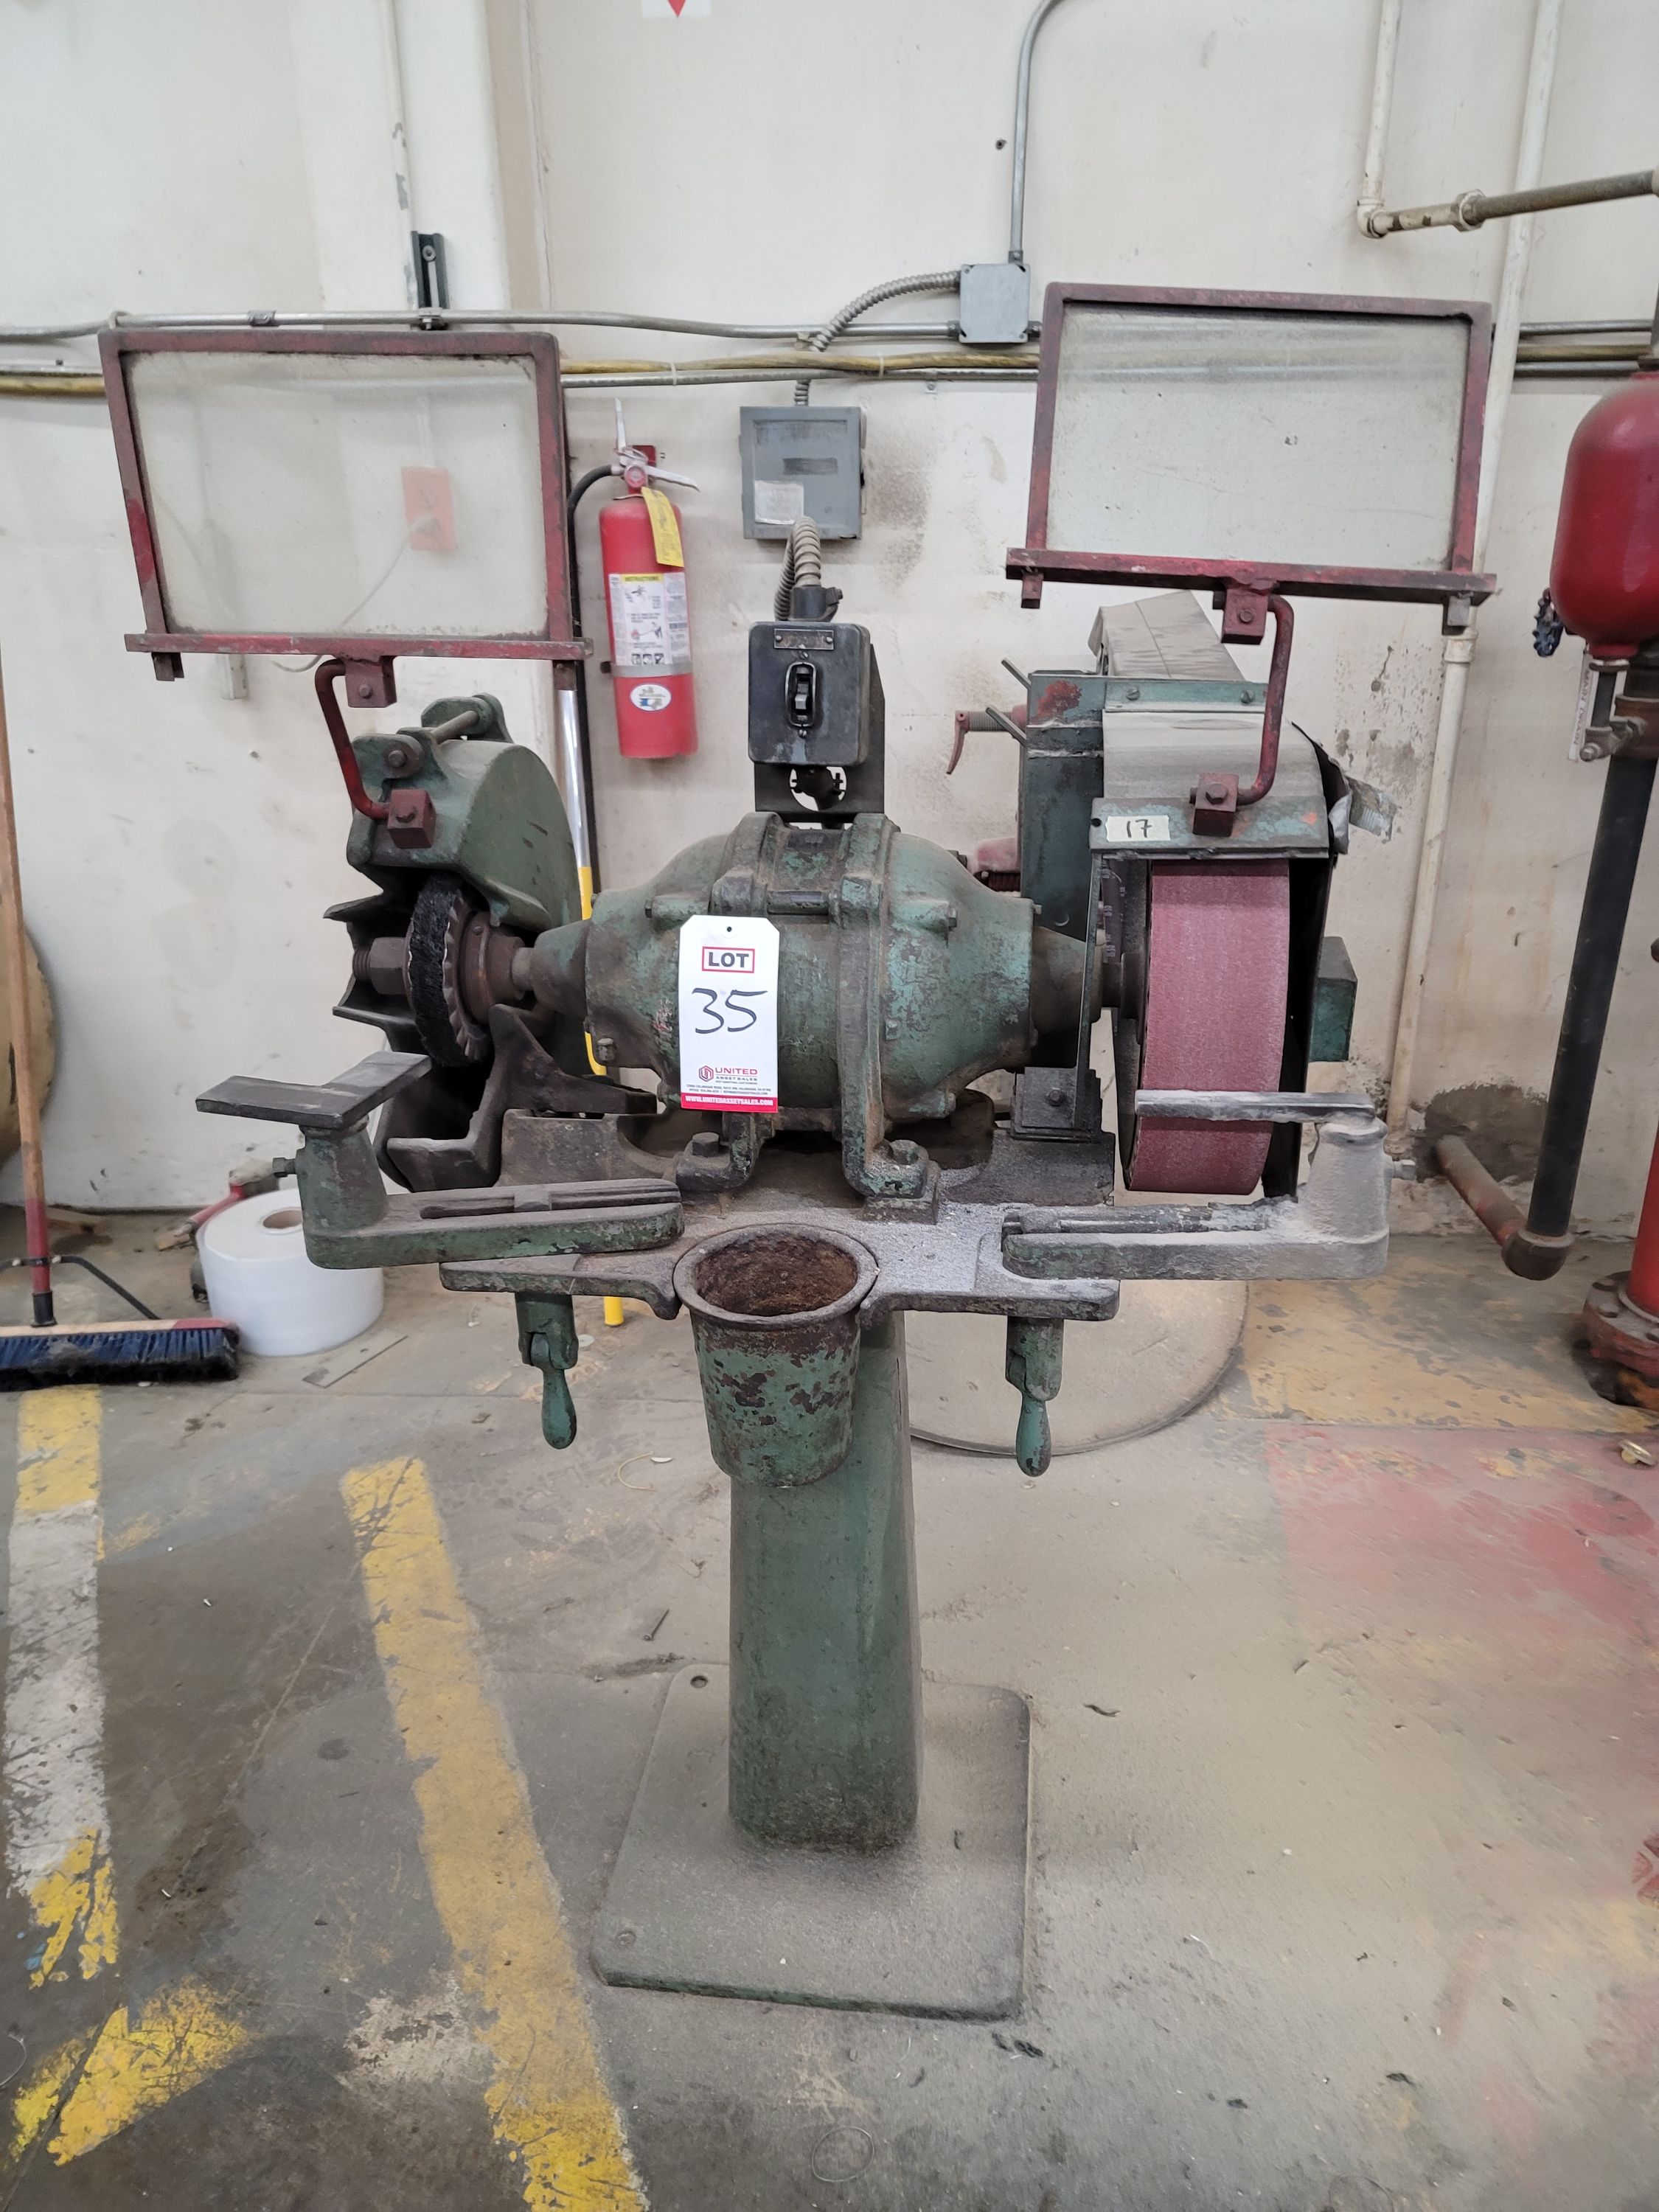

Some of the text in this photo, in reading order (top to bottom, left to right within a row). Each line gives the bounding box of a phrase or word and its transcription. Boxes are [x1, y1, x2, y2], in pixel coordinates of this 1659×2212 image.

[1126, 819, 1152, 838] 17
[708, 951, 749, 968] LOT
[692, 987, 768, 1034] 35
[714, 1067, 758, 1075] UNITED
